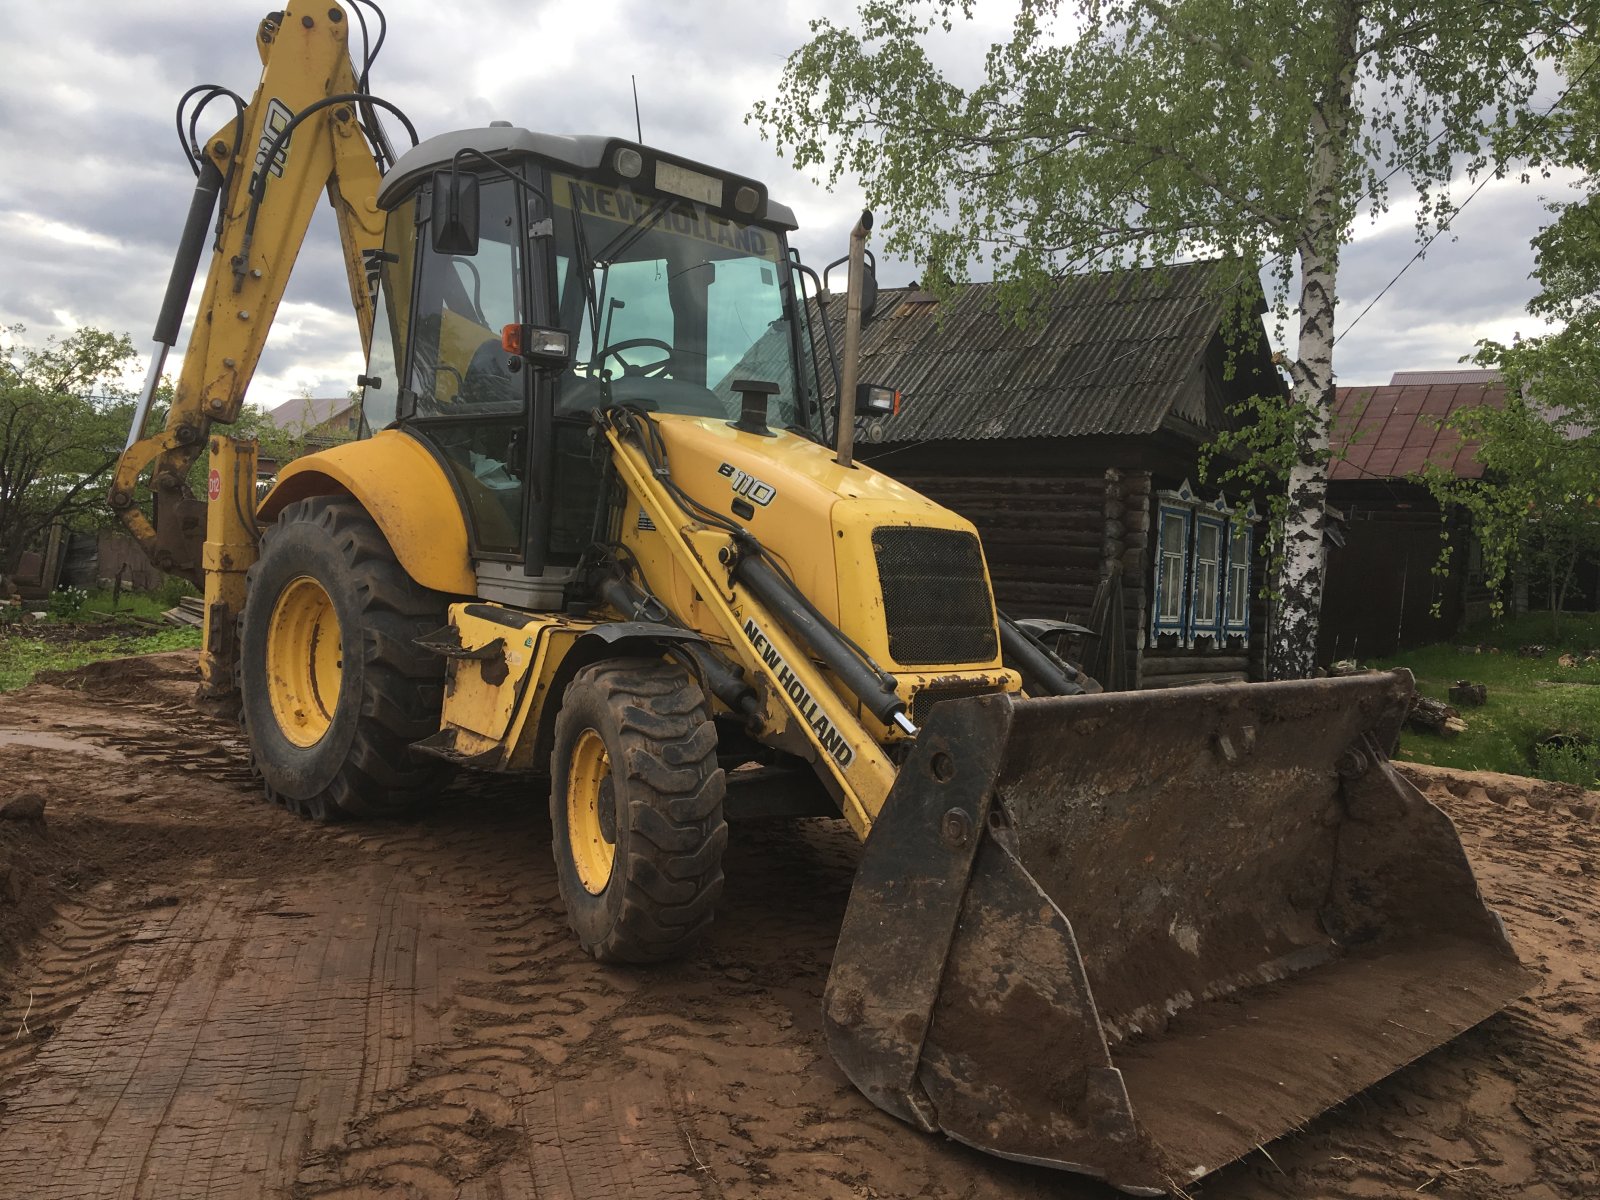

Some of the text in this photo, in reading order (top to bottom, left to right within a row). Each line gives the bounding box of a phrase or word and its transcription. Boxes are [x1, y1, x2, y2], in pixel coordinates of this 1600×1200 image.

[570, 182, 644, 224] NEW
[743, 619, 853, 766] NEW HOLLAND
